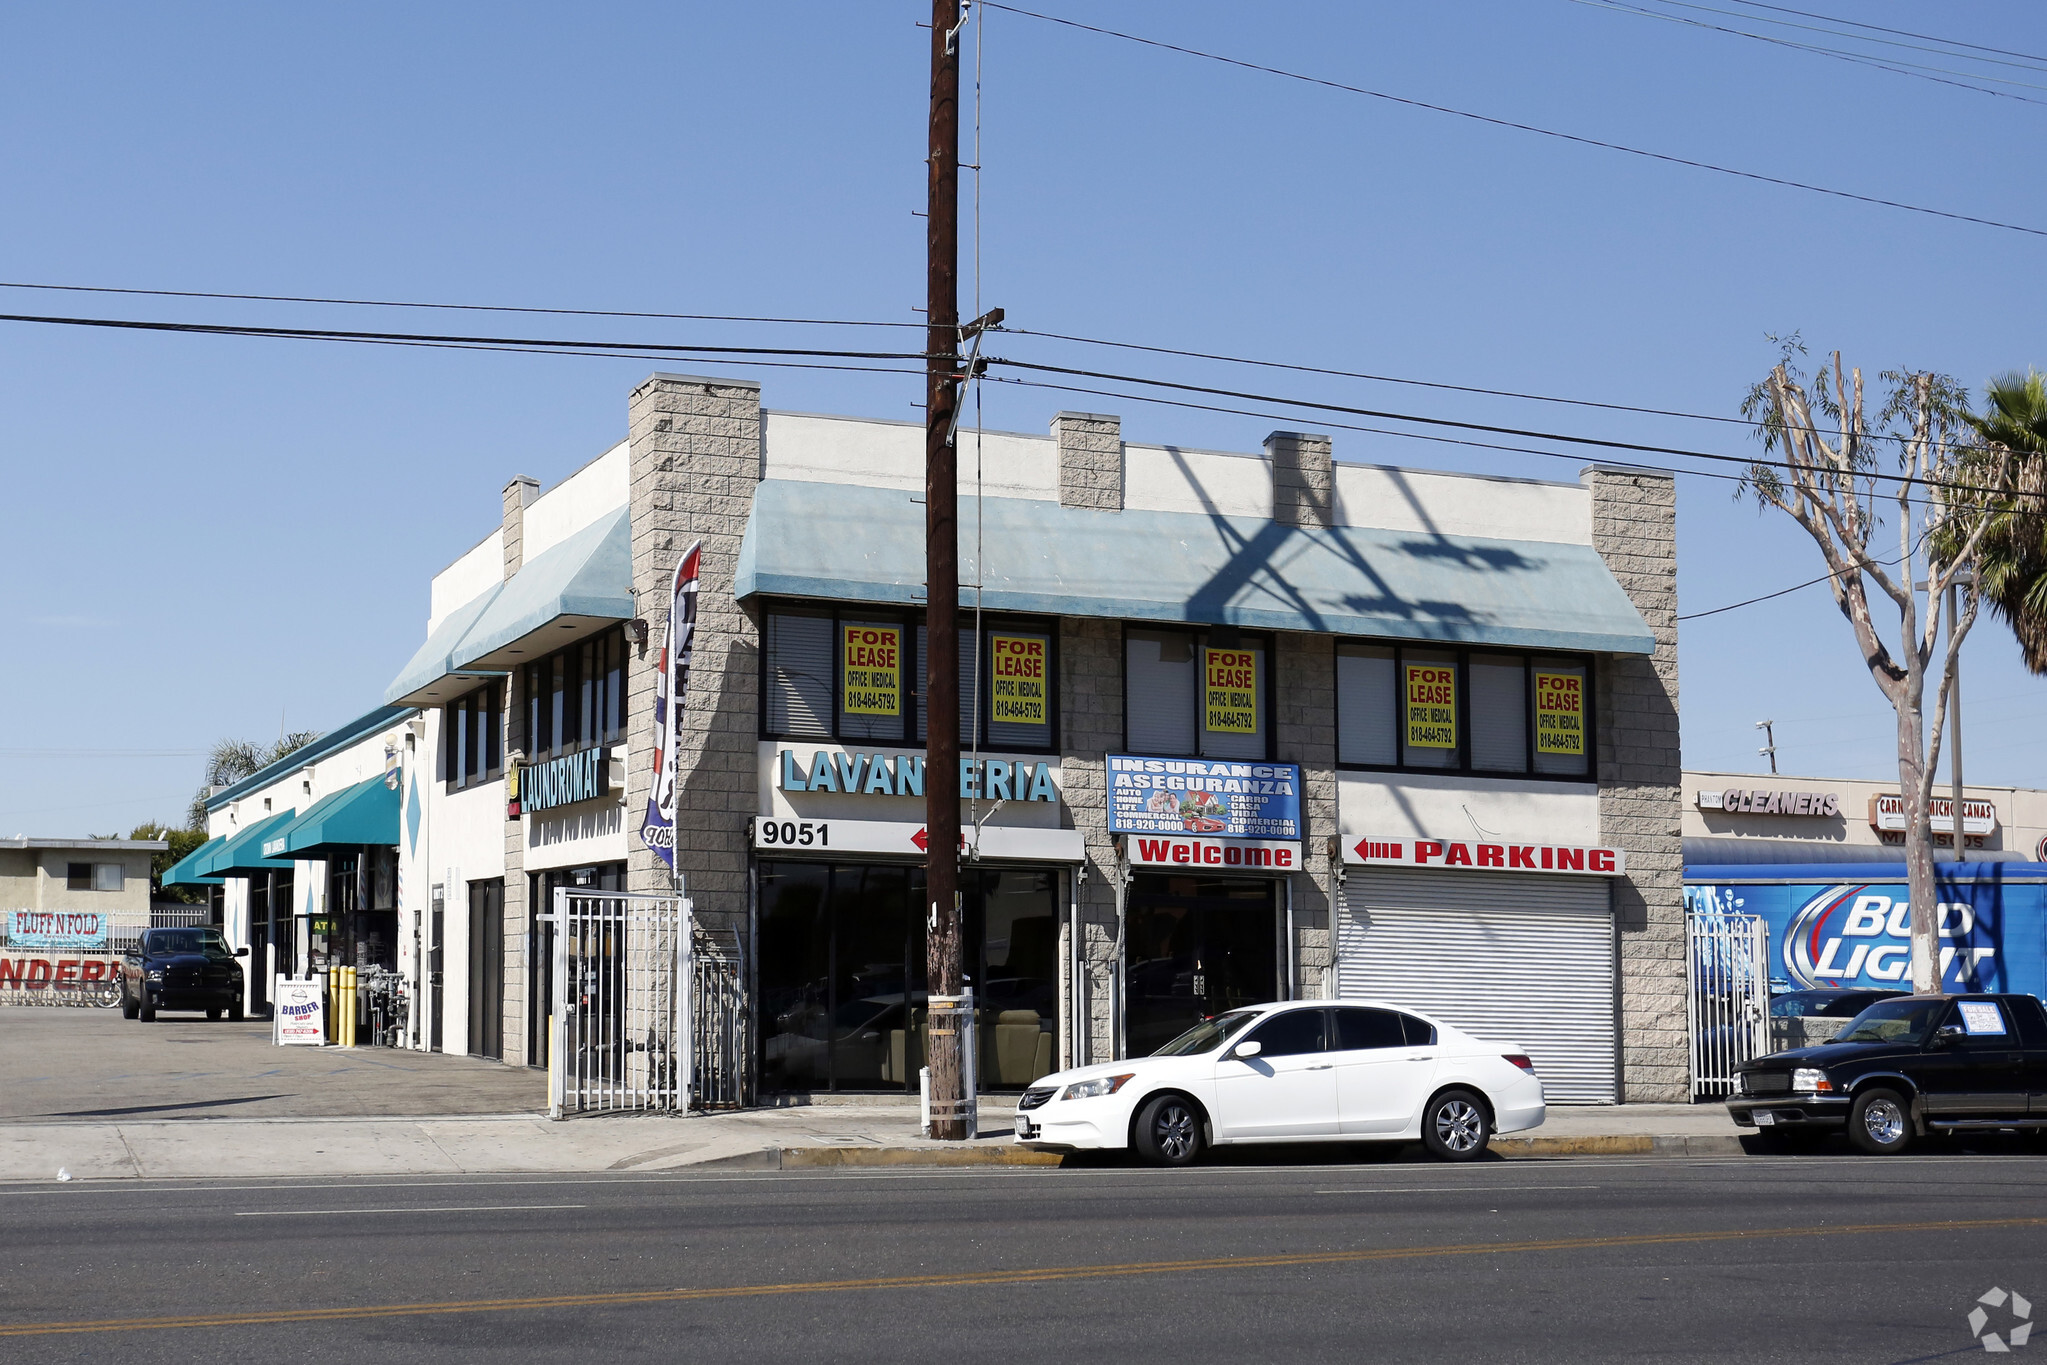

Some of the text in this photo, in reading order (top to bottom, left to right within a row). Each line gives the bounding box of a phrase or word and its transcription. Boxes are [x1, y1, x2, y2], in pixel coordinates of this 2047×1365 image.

[848, 630, 896, 646] FOR
[996, 640, 1042, 656] FOR
[848, 647, 895, 668] LEASE
[996, 656, 1041, 677] LEASE
[1208, 652, 1252, 667] FOR
[848, 671, 895, 688] OFFICE MEDICAL
[1209, 668, 1252, 688] LEASE
[1410, 669, 1452, 684] FOR
[1539, 677, 1579, 691] FOR
[996, 680, 1041, 697] OFFICE MEDICAL
[1410, 684, 1451, 704] LEASE
[848, 691, 895, 709] 818-464-5792
[1209, 691, 1252, 708] OFFICE MEDICAL
[1539, 692, 1579, 711] LEASE
[996, 700, 1041, 718] 818-464-5792
[1411, 707, 1452, 723] OFFICE MEDICAL
[1210, 711, 1252, 728] 818-464-5792
[1540, 714, 1579, 730] OFFICE MEDICAL
[1411, 726, 1451, 743] 818-464-5792
[1541, 733, 1579, 749] 818-464-5792
[782, 750, 1056, 801] LAVANERIA
[1111, 759, 1292, 780] INSURANCE
[521, 747, 601, 813] LAUNDROMAT
[1114, 773, 1293, 796] ASEGURANZA
[1723, 789, 1839, 816] CLEANERS
[1928, 800, 1991, 819] MICHCANAS
[763, 821, 829, 846] 9051
[1115, 819, 1184, 831] 818-920-0000
[1227, 824, 1295, 836] 818-920-0000
[1138, 839, 1292, 867] Welcome
[1414, 840, 1615, 872] PARKING
[16, 912, 99, 935] FLUFF N FOLD
[1842, 895, 1976, 938] BUD
[281, 1001, 320, 1016] BARBER
